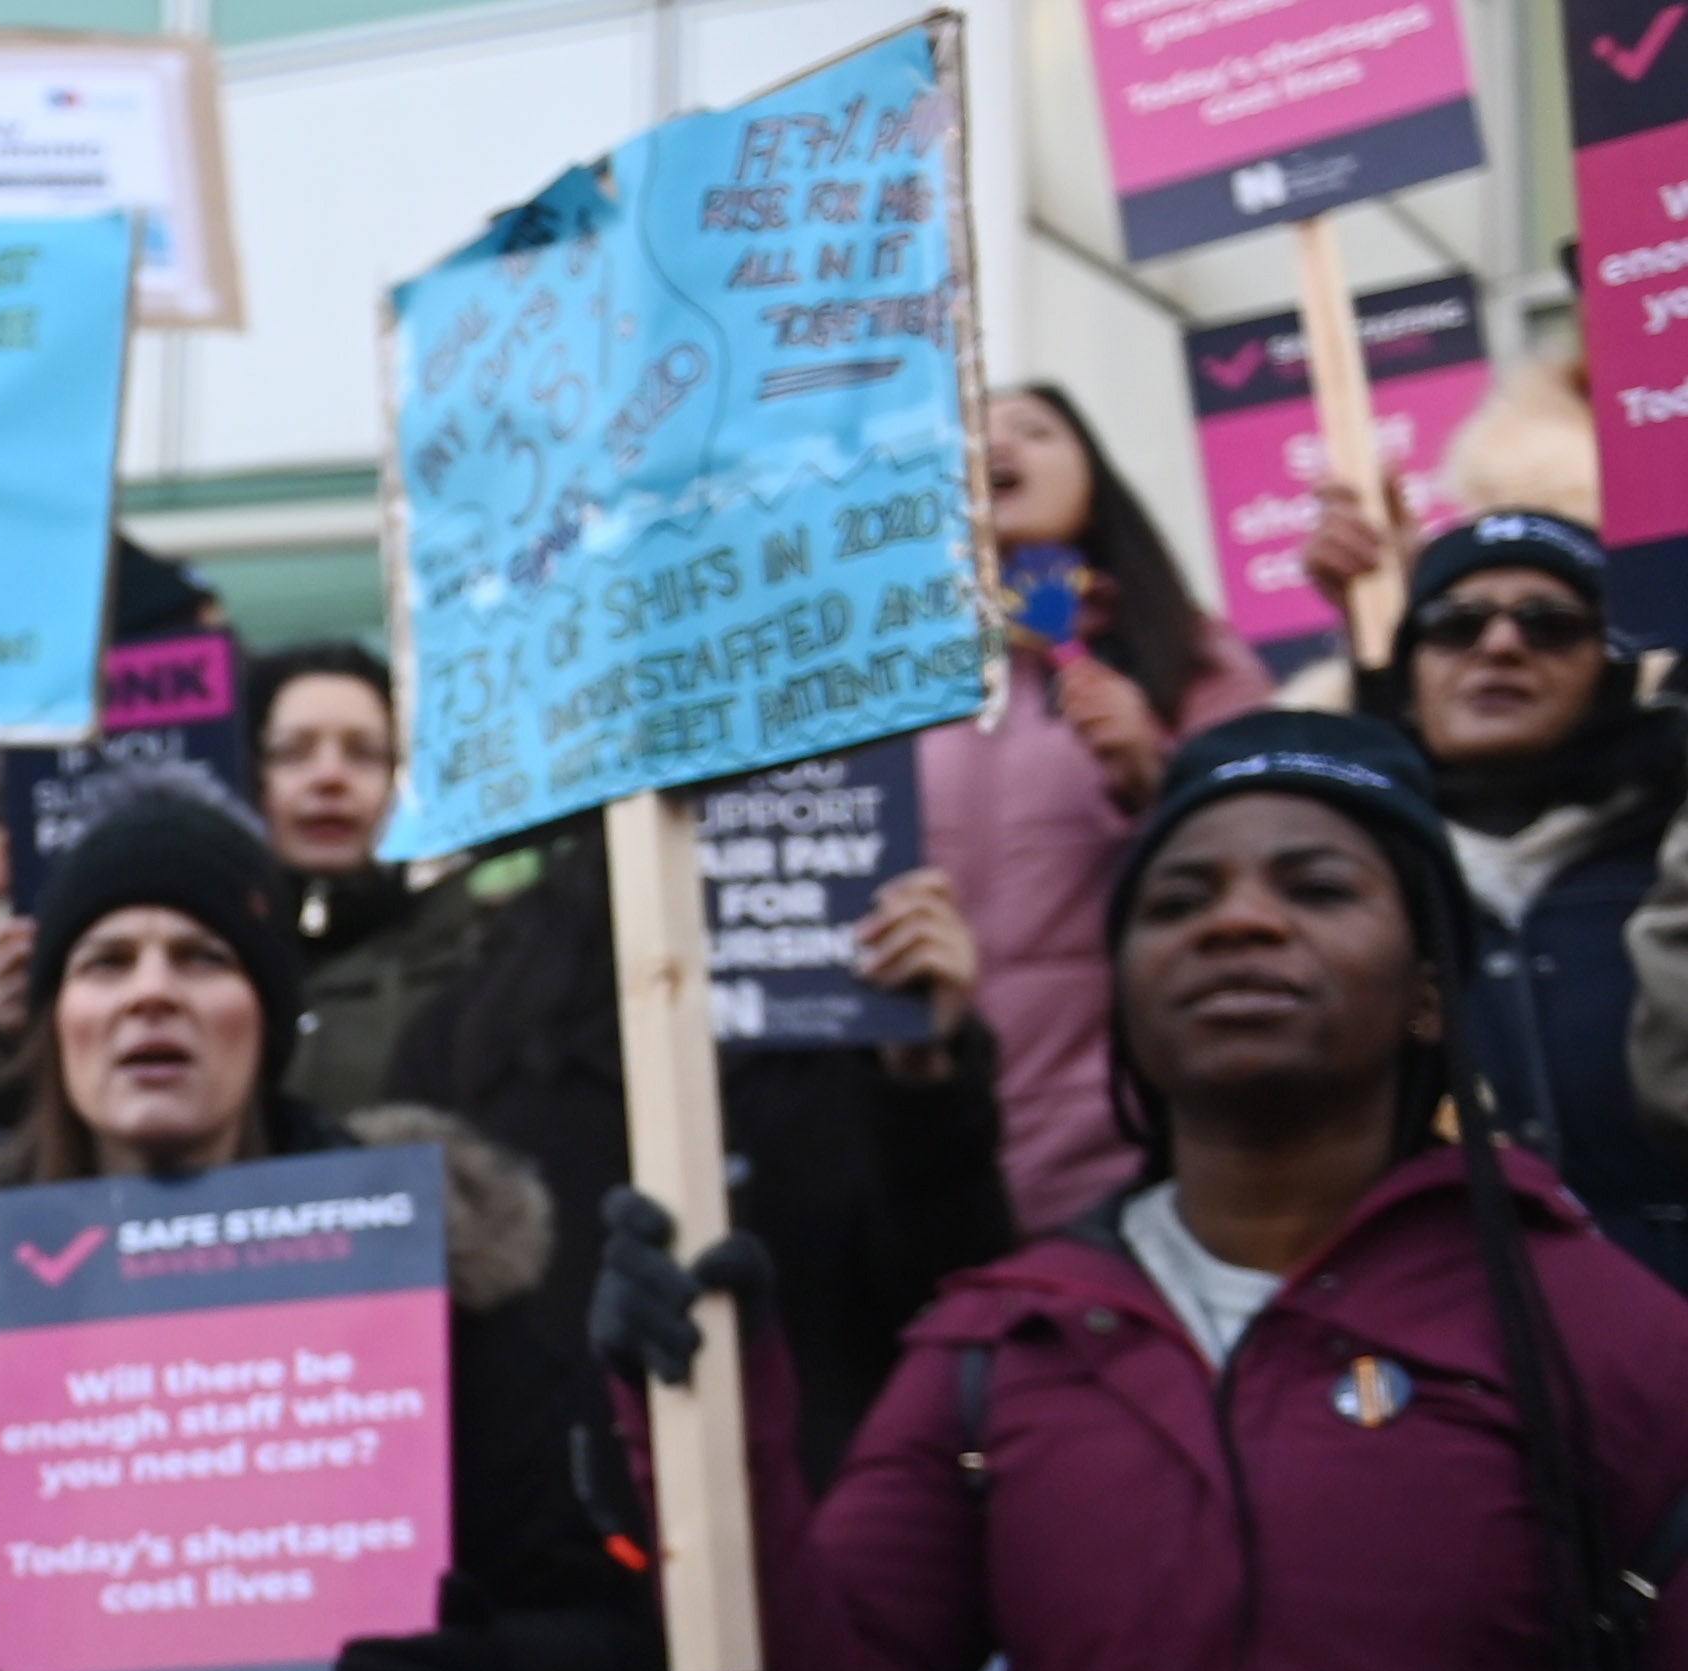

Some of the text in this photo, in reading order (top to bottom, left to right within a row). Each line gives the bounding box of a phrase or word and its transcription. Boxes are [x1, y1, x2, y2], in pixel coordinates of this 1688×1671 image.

[779, 832, 885, 878] PAY
[717, 879, 827, 925] FOR
[118, 1191, 415, 1255] SAFE STAFFING
[66, 1348, 354, 1407] Will there be
[0, 1385, 425, 1456] enough staff when
[38, 1428, 382, 1500] you need care?
[5, 1515, 416, 1578] Today's shortages
[99, 1564, 315, 1615] cost lives
